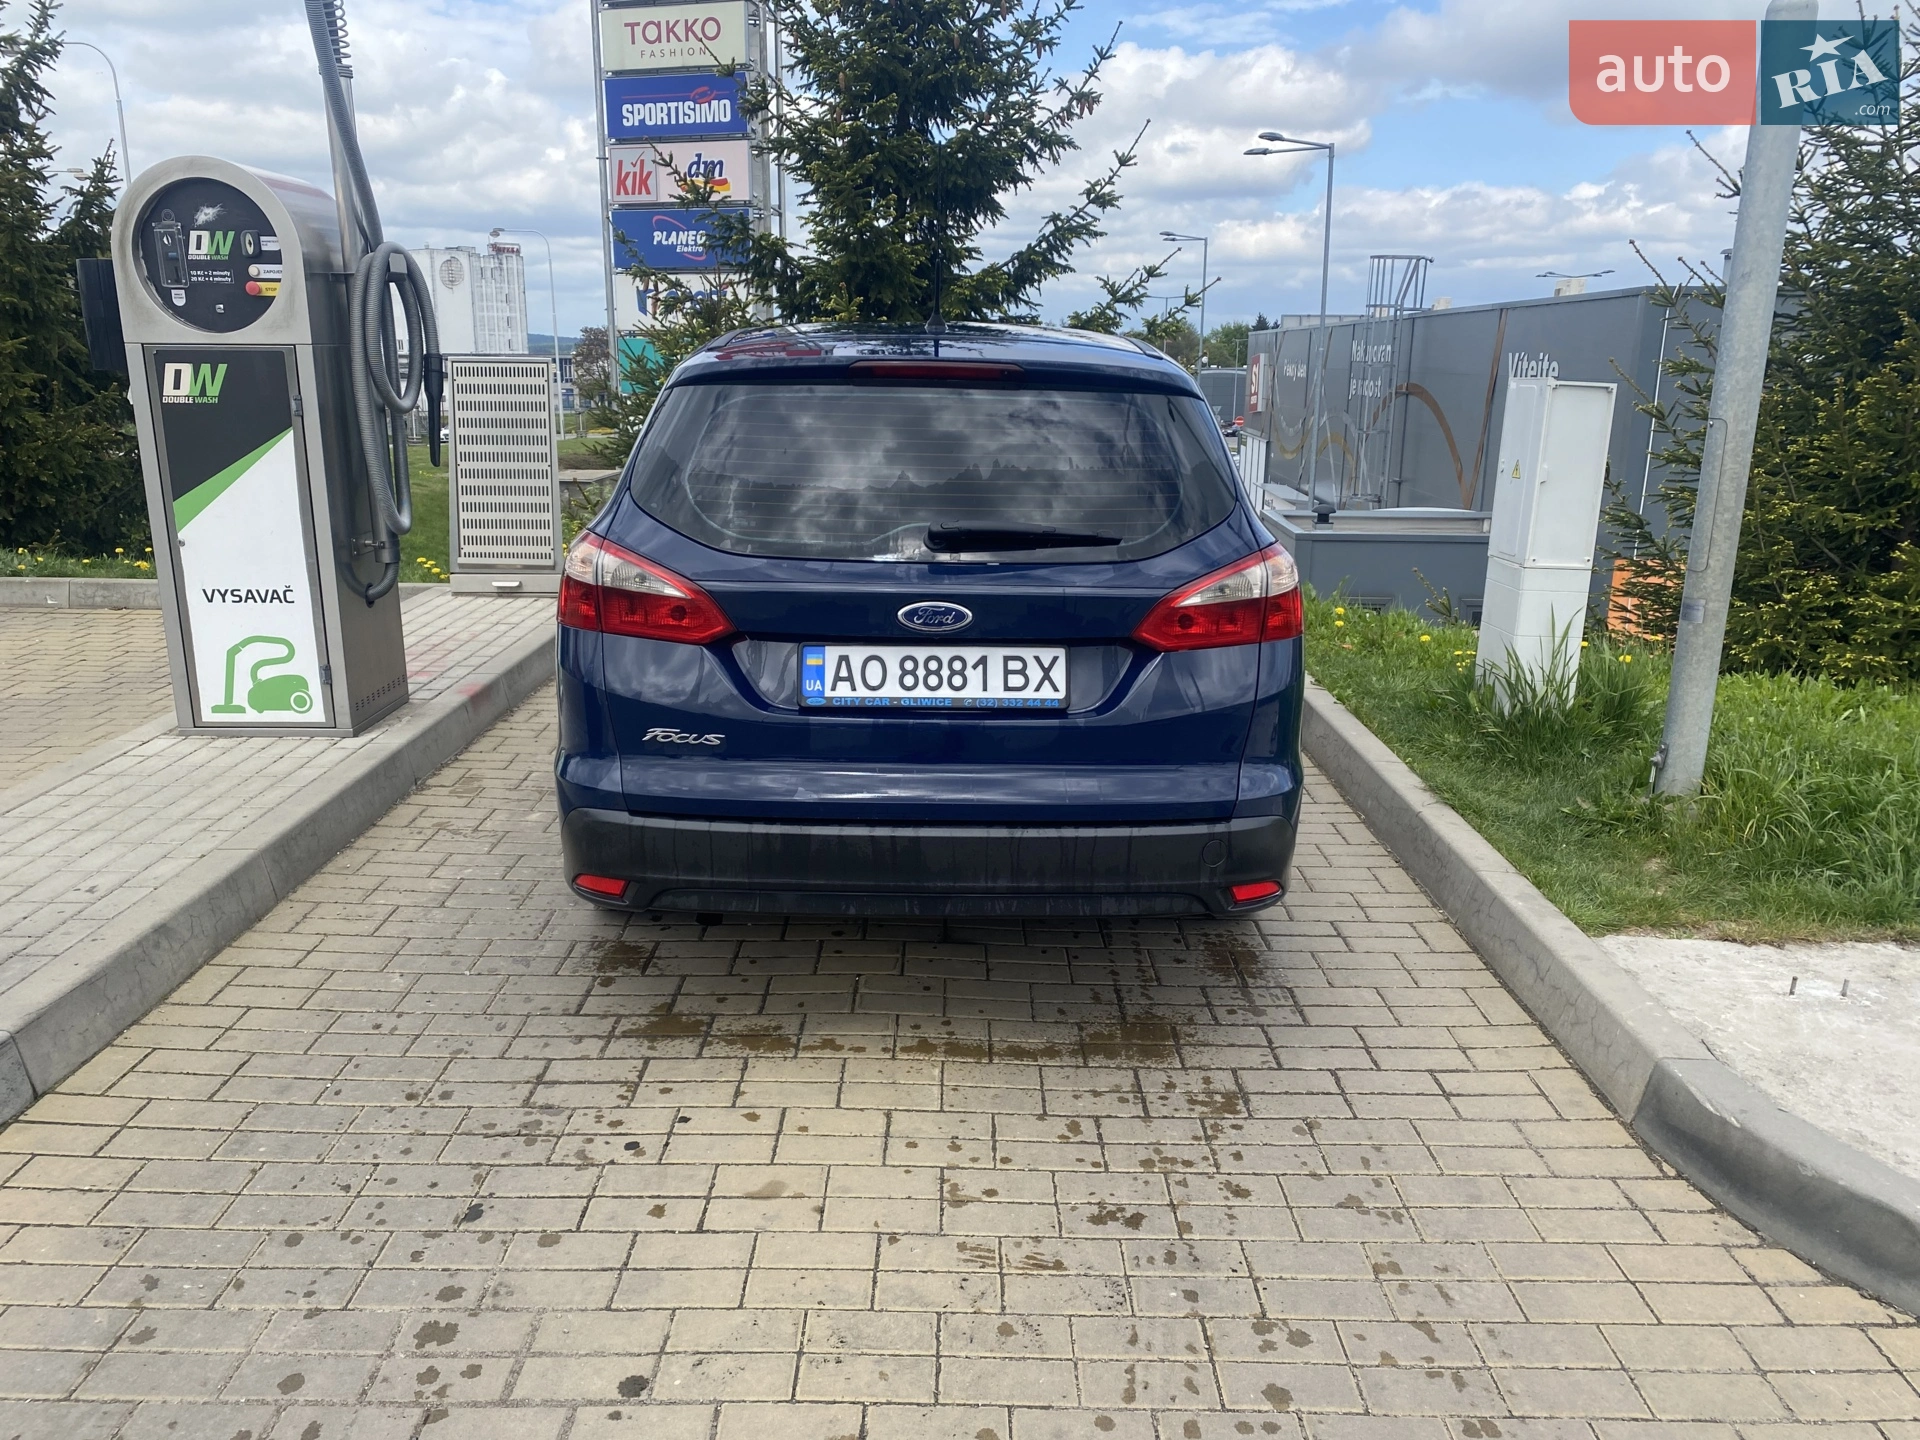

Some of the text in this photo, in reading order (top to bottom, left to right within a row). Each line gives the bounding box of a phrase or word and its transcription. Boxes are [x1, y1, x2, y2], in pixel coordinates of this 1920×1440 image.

[640, 46, 706, 59] FASHION
[687, 153, 724, 178] dm
[616, 158, 653, 196] kik
[188, 230, 235, 255] DW
[653, 231, 706, 245] PLANEO
[676, 245, 703, 253] Elektro
[163, 362, 228, 396] DW
[162, 396, 219, 404] DOUBLE WASH
[202, 585, 295, 604] VYSAVAČ
[913, 606, 956, 625] Ford
[830, 655, 1060, 692] AO 8881 BX
[806, 680, 823, 691] UA
[832, 697, 861, 706] CITY
[865, 697, 890, 706] CAR
[901, 697, 953, 707] GLIWICE
[976, 698, 998, 708] (32)
[1002, 698, 1023, 708] 332
[1026, 698, 1042, 708] 44
[1044, 698, 1059, 708] 44
